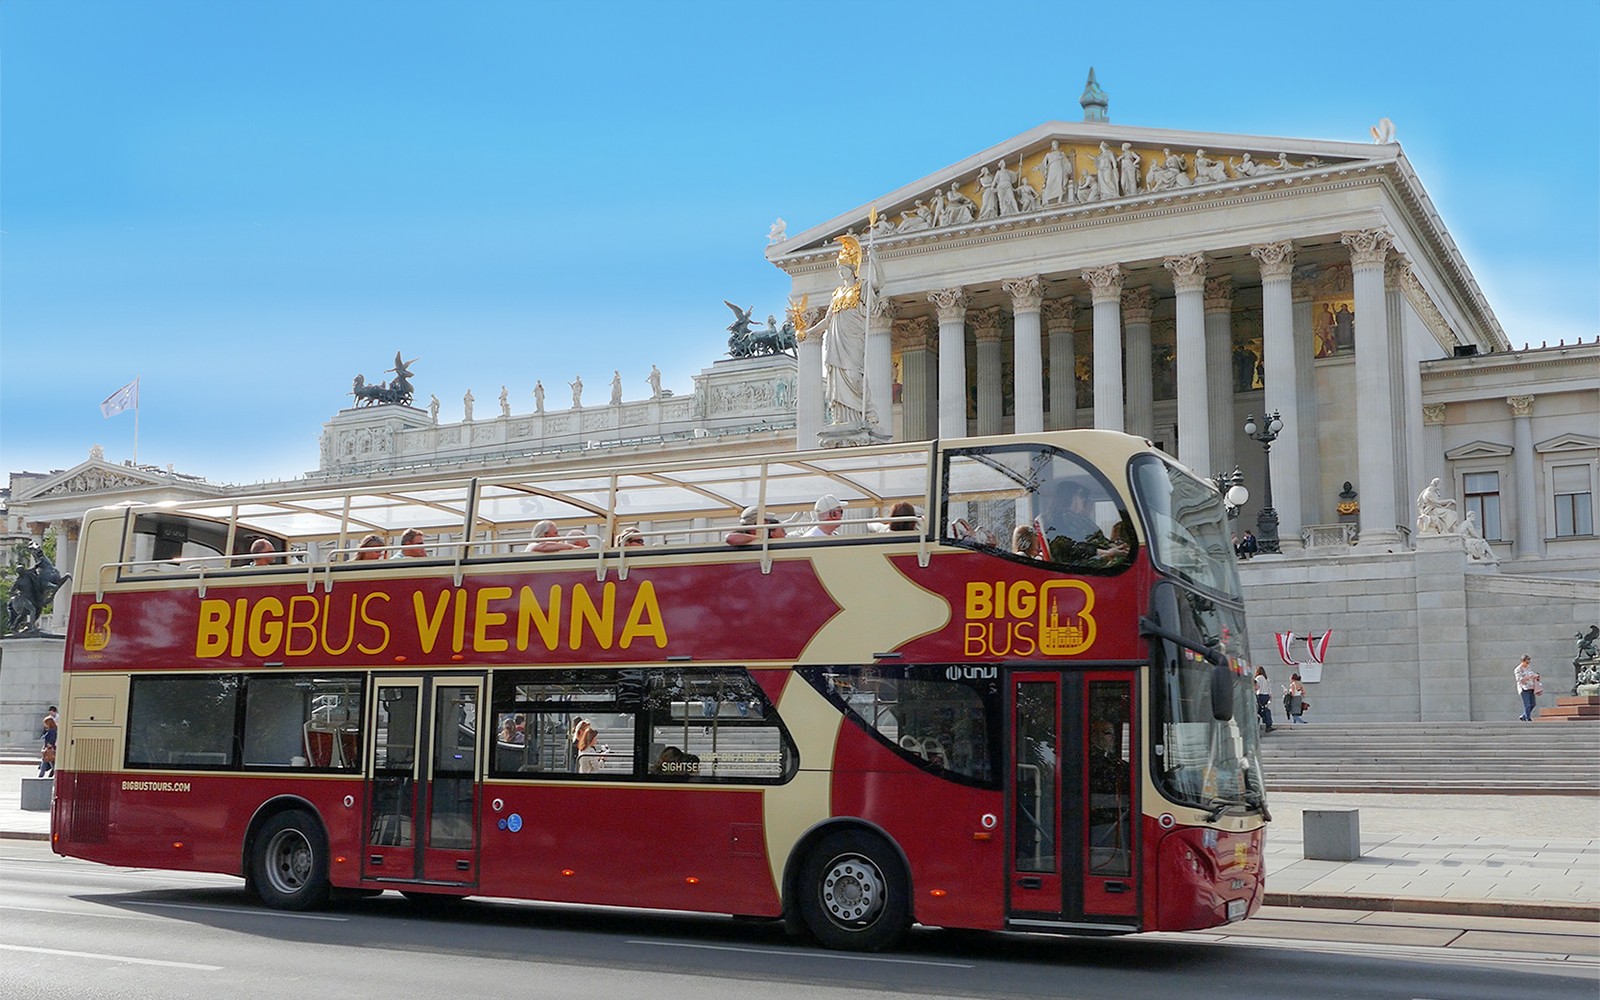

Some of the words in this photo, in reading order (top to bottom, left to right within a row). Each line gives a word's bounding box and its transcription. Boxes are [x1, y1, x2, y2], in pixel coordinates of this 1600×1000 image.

[412, 579, 668, 654] VIENNA
[965, 580, 1037, 619] BIG
[964, 621, 1036, 656] BUS
[121, 780, 191, 793] BIGBUSTOURS.COM
